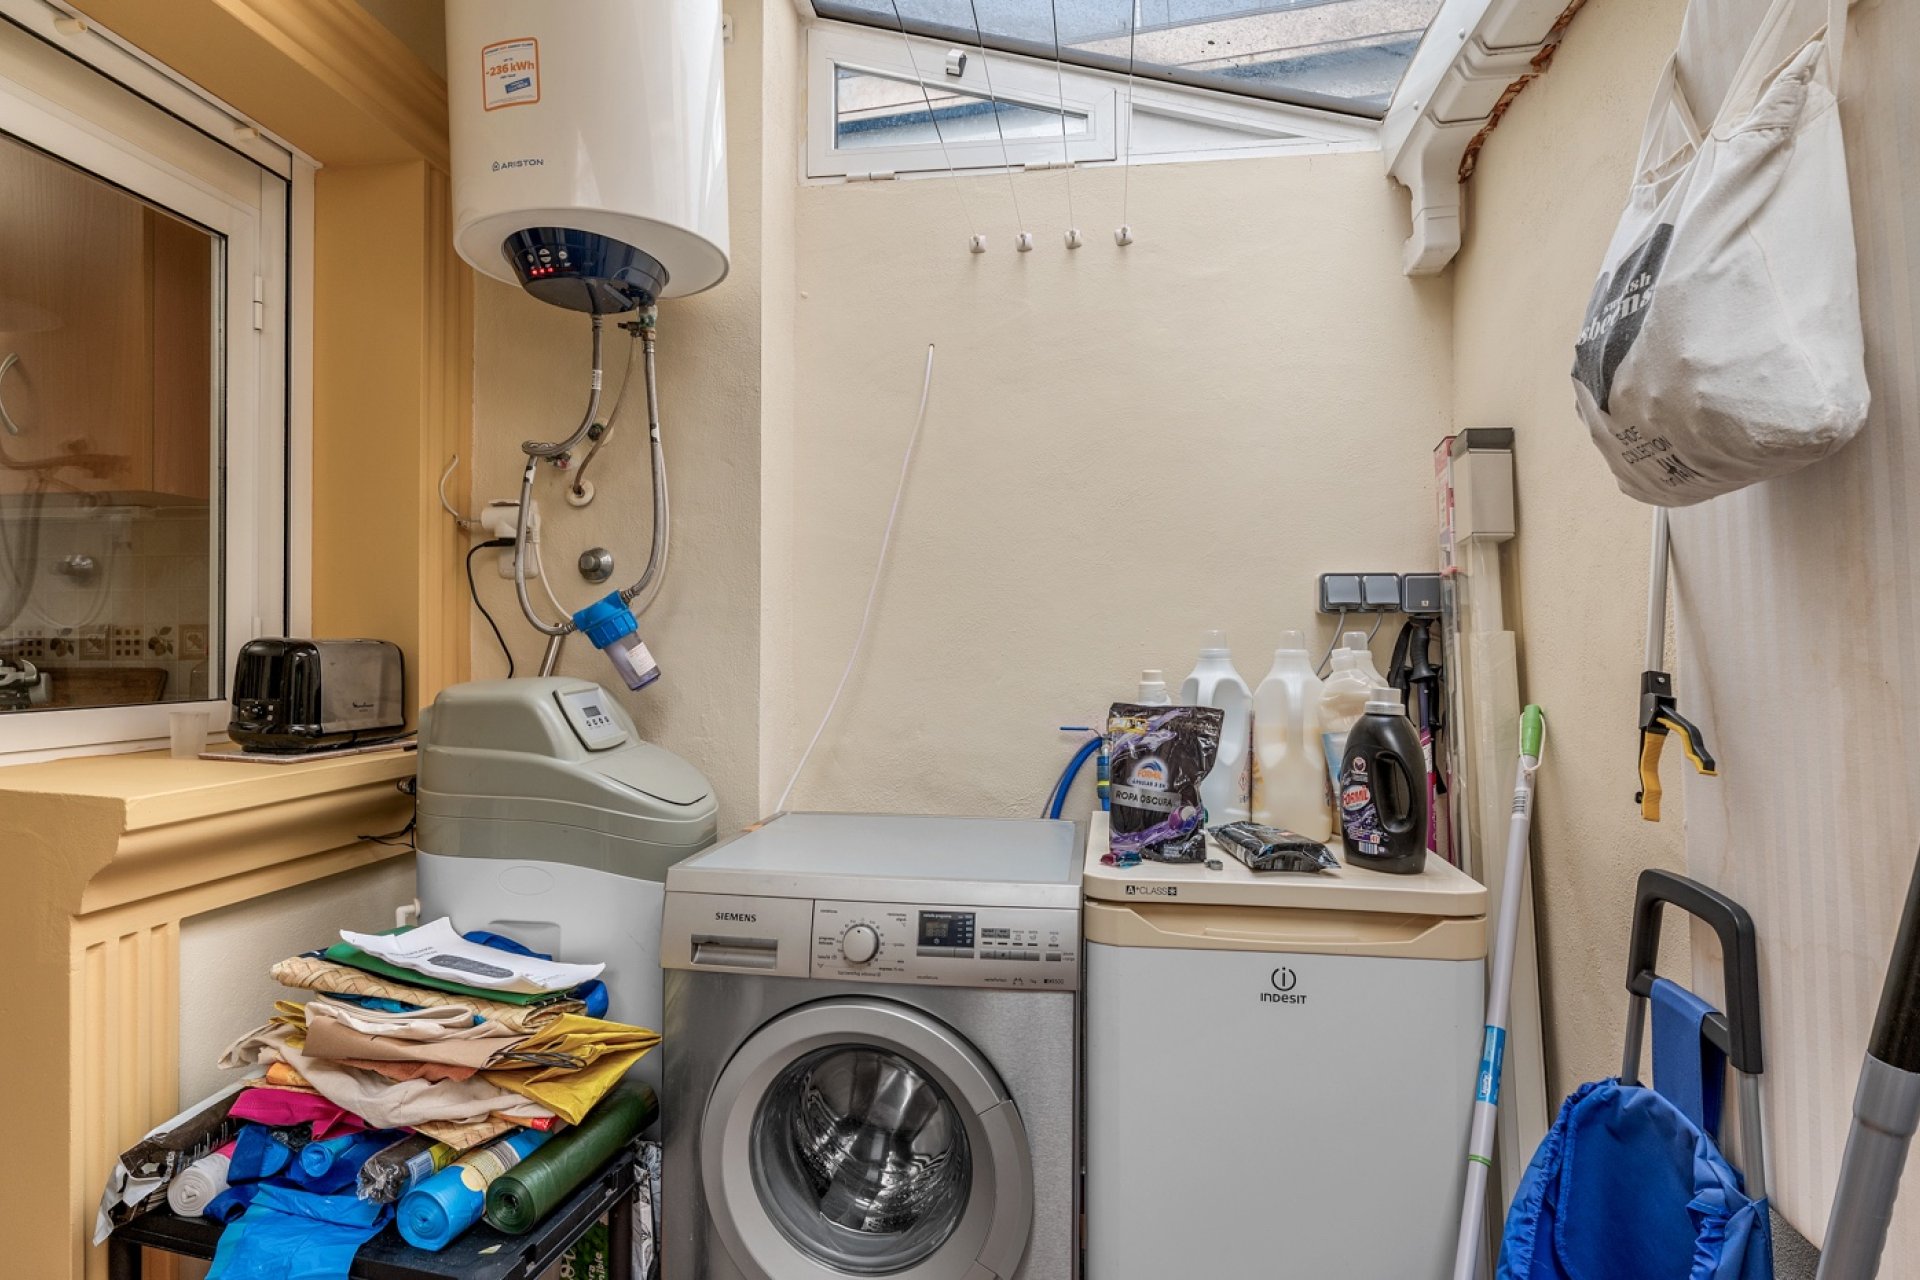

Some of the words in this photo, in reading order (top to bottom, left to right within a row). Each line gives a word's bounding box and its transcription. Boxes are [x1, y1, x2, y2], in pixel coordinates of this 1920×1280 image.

[510, 61, 535, 72] kWh
[501, 159, 544, 170] ARISTON
[1115, 790, 1139, 803] ROPA
[1140, 794, 1173, 808] OSCURA
[715, 912, 757, 923] SIEMENS
